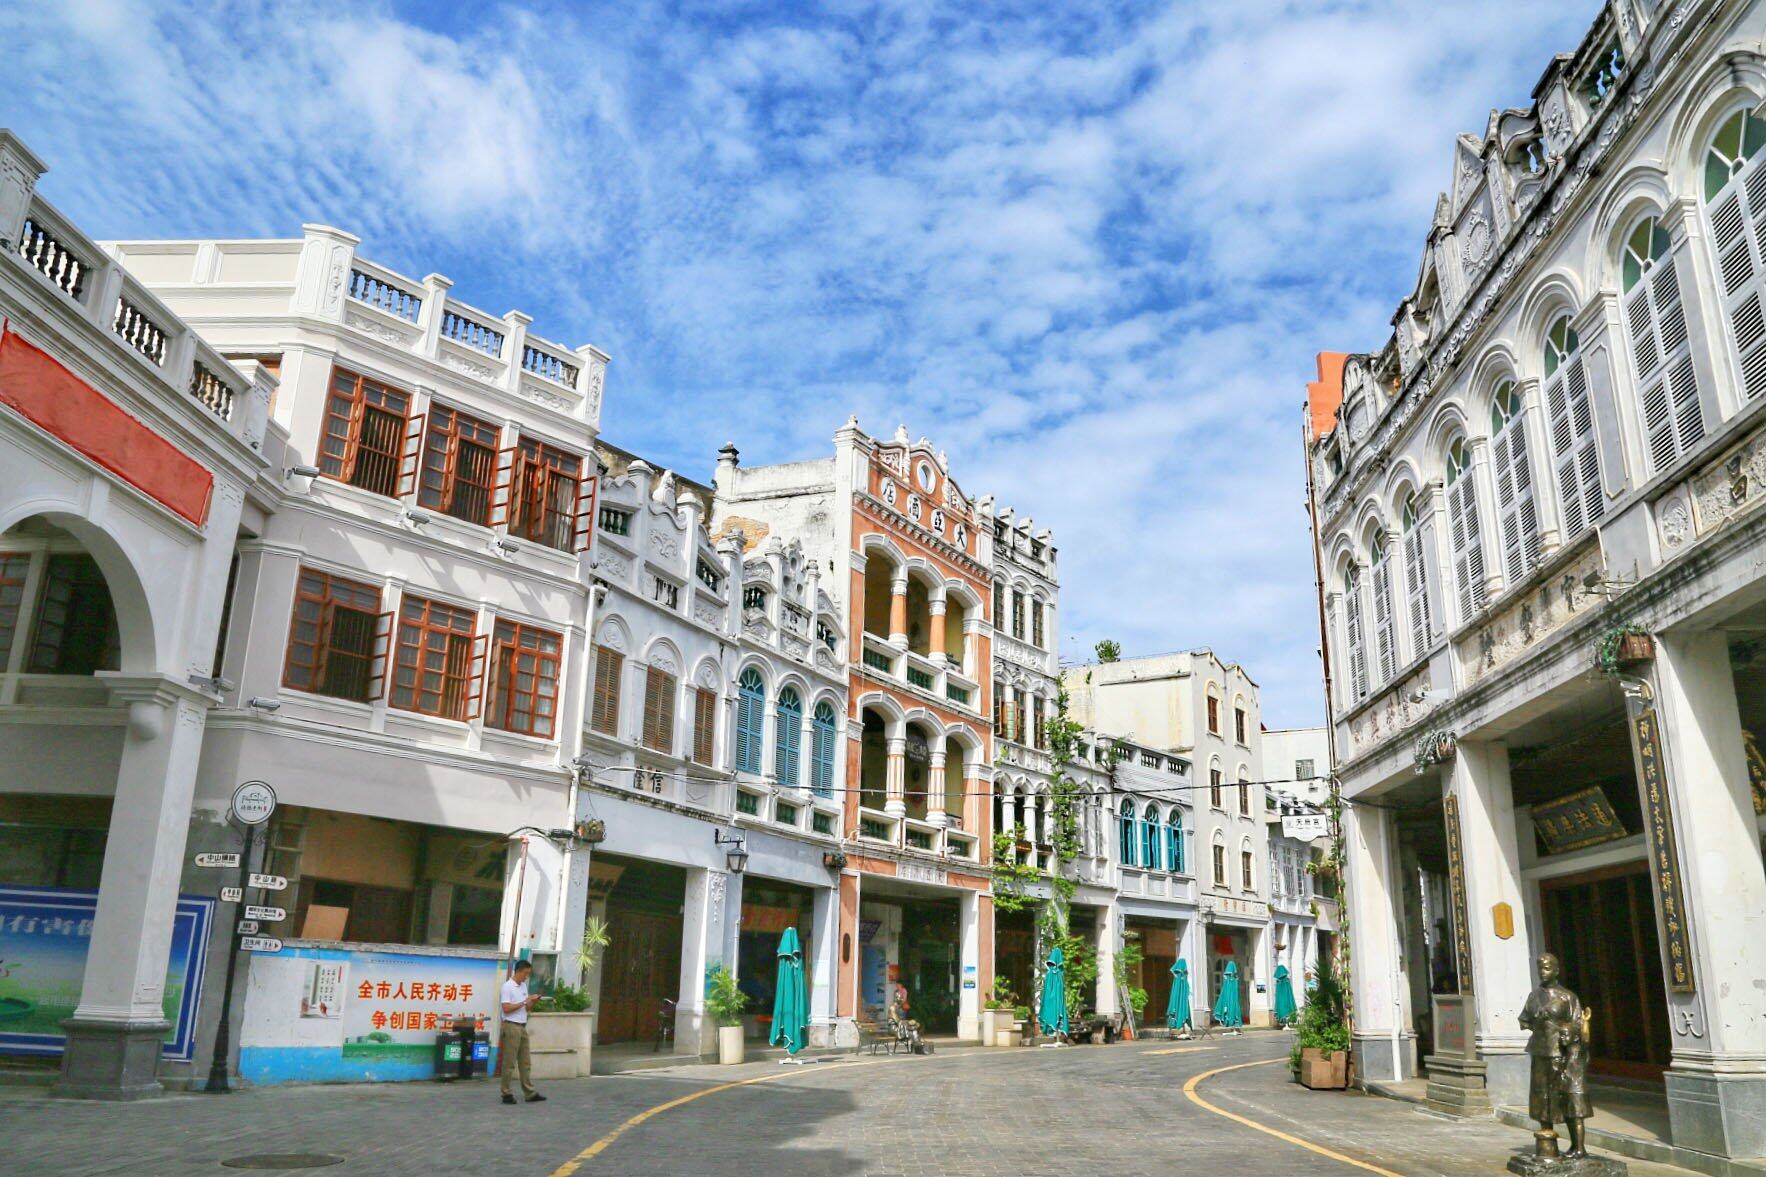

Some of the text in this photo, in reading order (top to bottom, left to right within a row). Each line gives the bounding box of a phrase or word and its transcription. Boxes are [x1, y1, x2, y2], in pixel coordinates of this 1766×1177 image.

[358, 980, 473, 1002] 全市人民齐动手
[371, 1010, 486, 1031] 争创国家卫城
